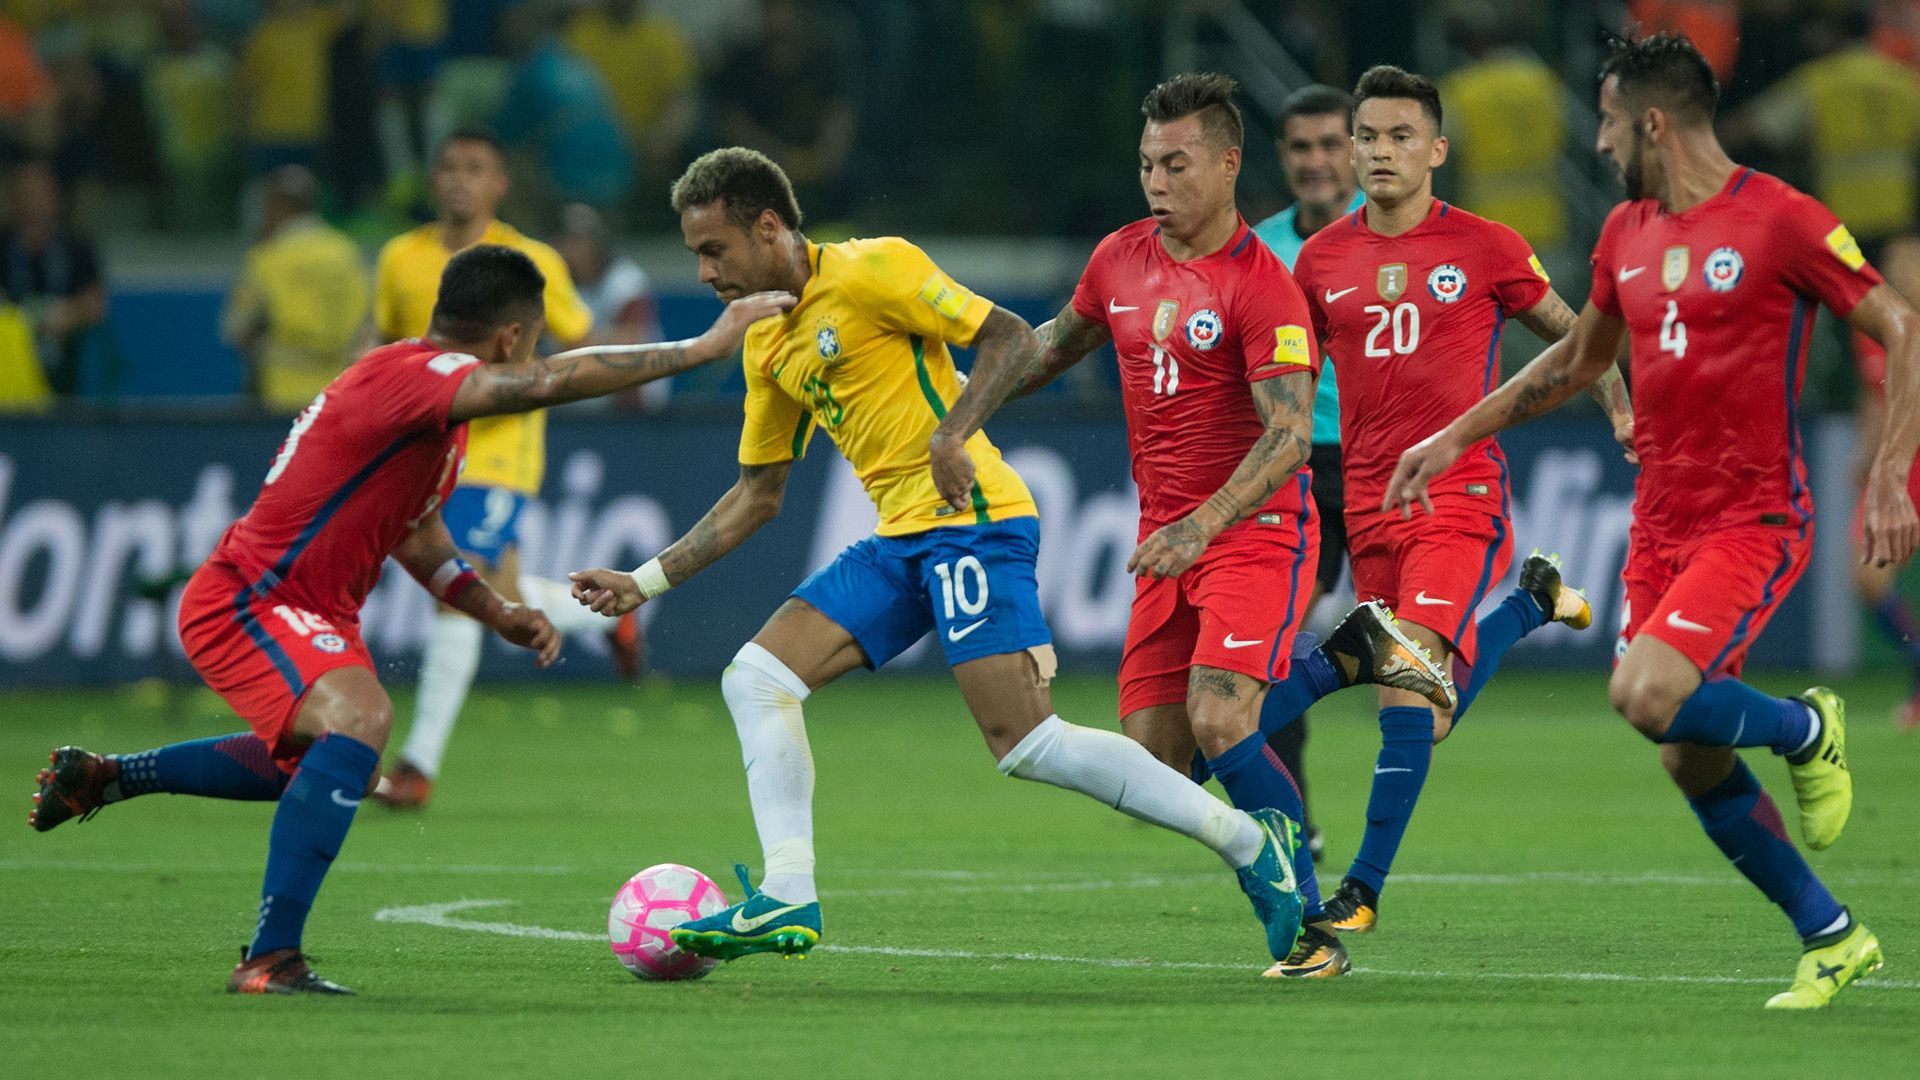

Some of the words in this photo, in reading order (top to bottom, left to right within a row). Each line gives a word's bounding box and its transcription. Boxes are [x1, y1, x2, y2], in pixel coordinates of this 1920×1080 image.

[1363, 302, 1420, 358] 20
[1659, 299, 1688, 360] 4
[1148, 343, 1179, 396] 11
[934, 554, 989, 619] 10
